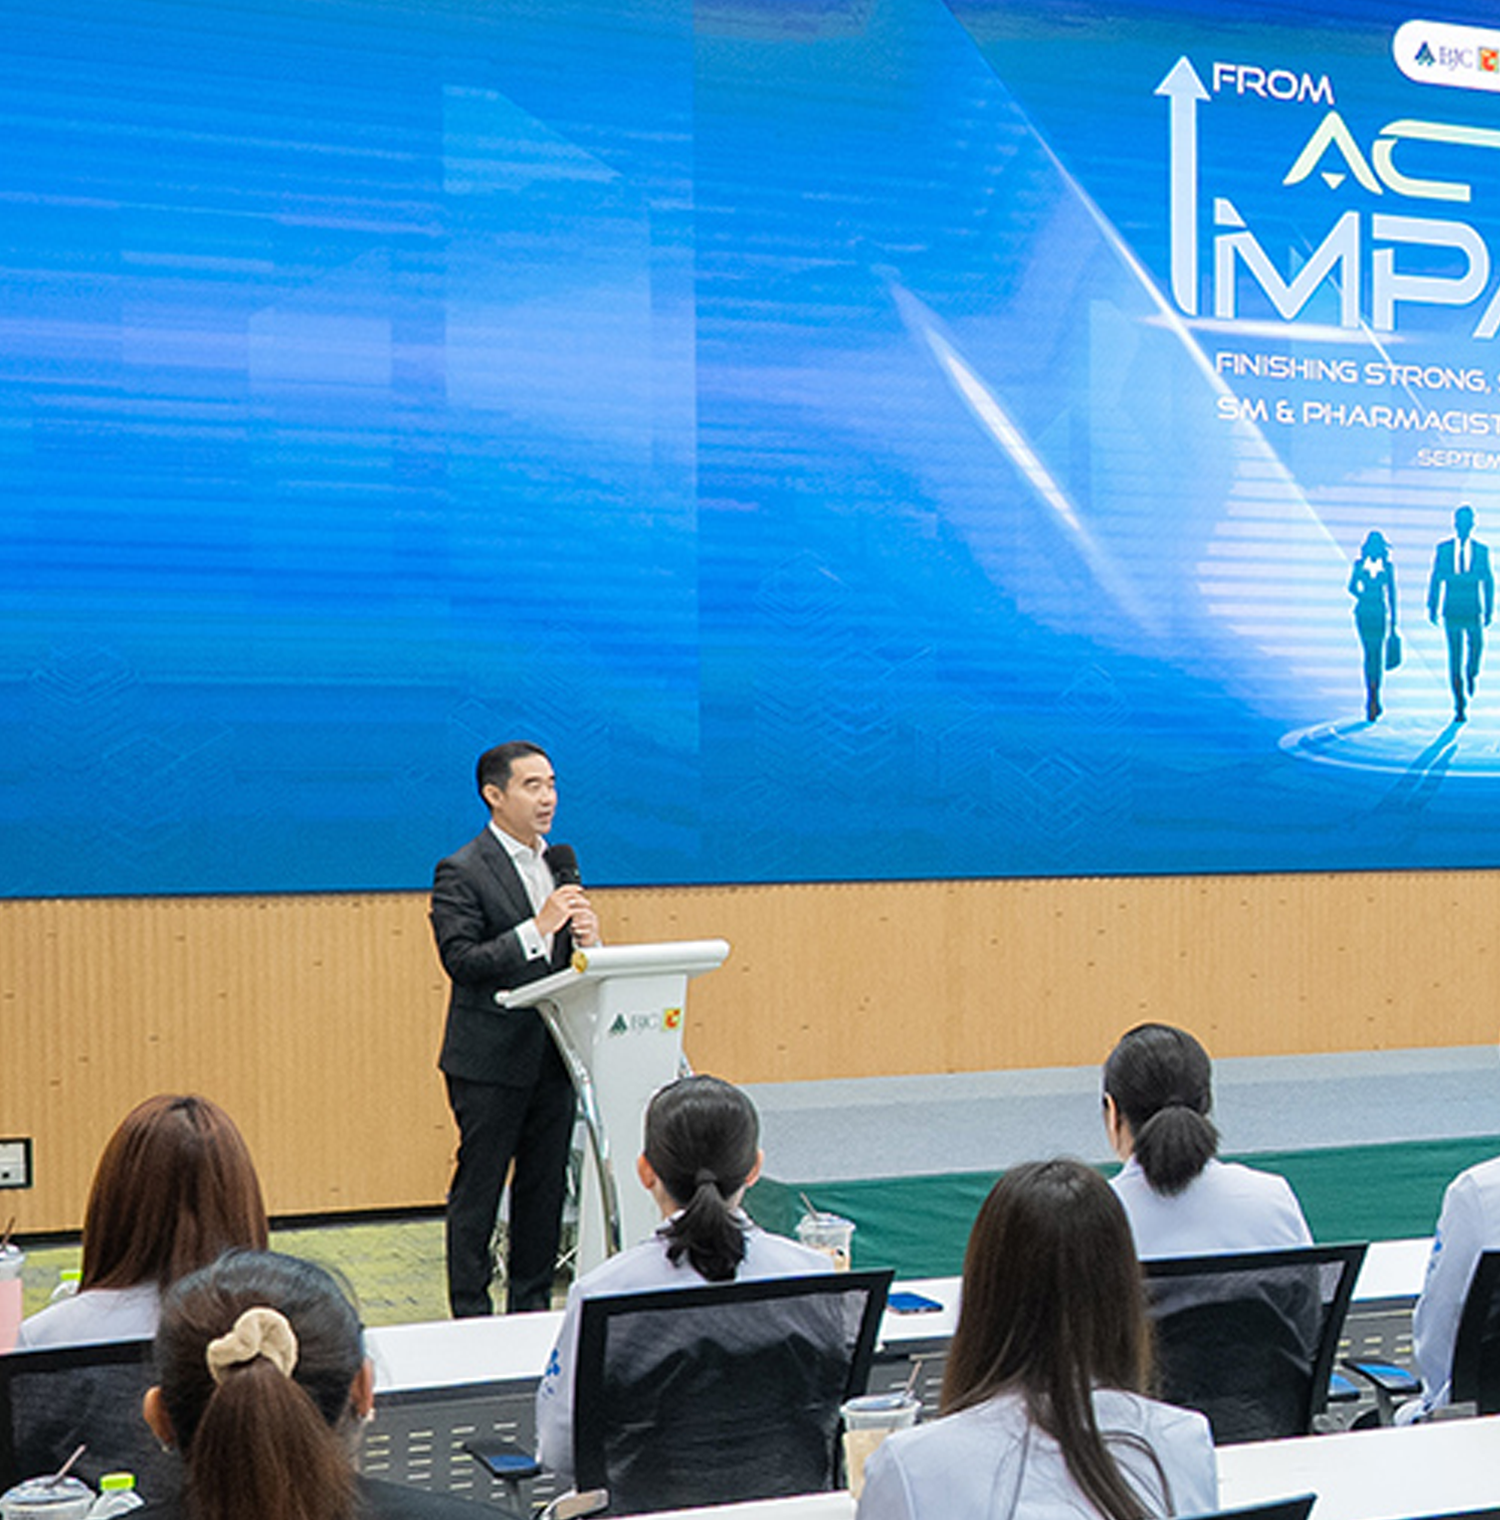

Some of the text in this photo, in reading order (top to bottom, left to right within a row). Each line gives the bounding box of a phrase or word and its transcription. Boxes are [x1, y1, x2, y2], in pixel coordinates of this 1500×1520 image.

[1213, 61, 1336, 106] FROM
[1215, 352, 1359, 384] FINISHING
[1364, 361, 1493, 395] STRONG,
[1217, 395, 1269, 423] SM
[1275, 399, 1296, 425] &
